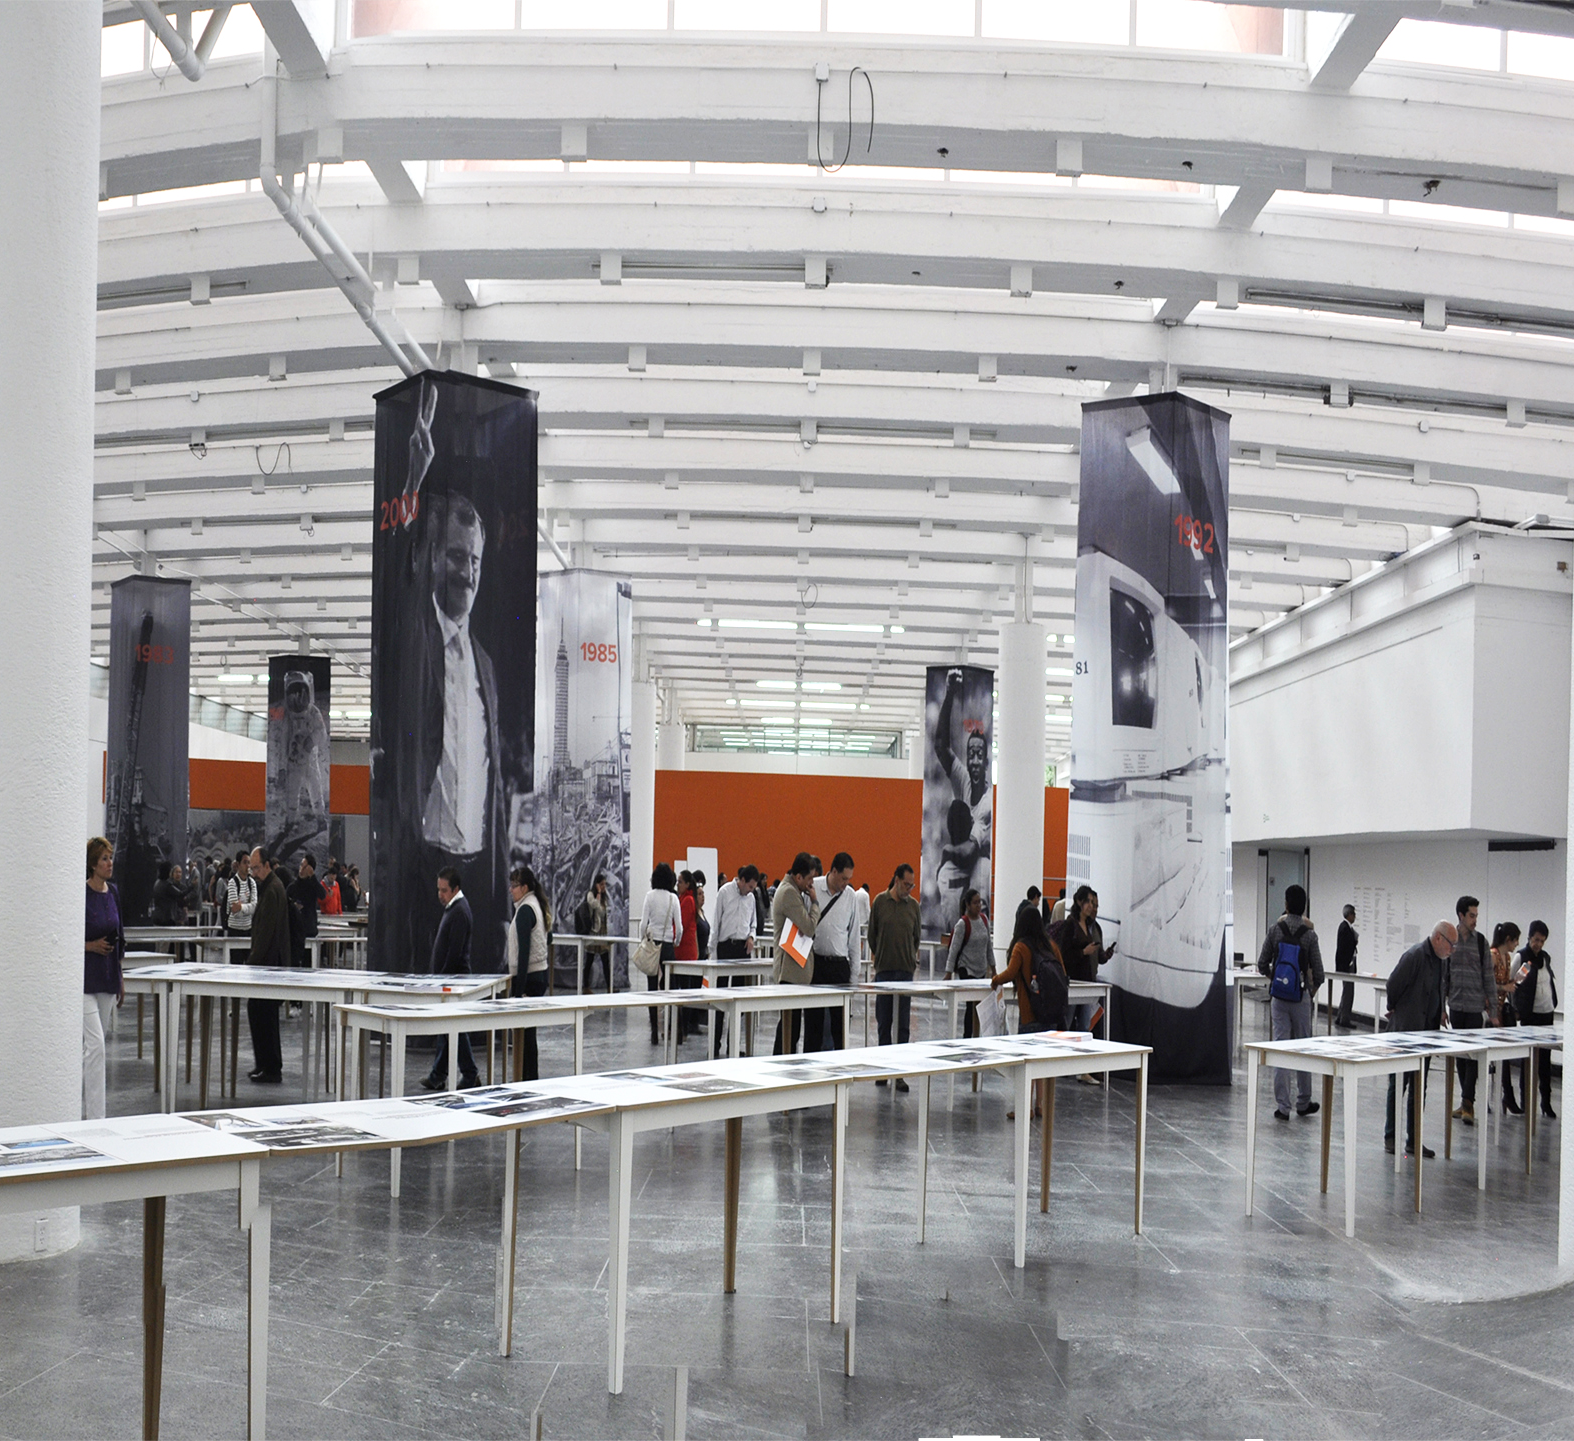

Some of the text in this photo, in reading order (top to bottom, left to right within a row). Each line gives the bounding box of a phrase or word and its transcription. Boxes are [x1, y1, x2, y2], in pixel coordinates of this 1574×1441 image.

[380, 490, 420, 531] 2000
[1174, 513, 1214, 554] 1992
[135, 643, 174, 665] 1983
[580, 641, 617, 664] 1985
[1075, 660, 1089, 675] 81
